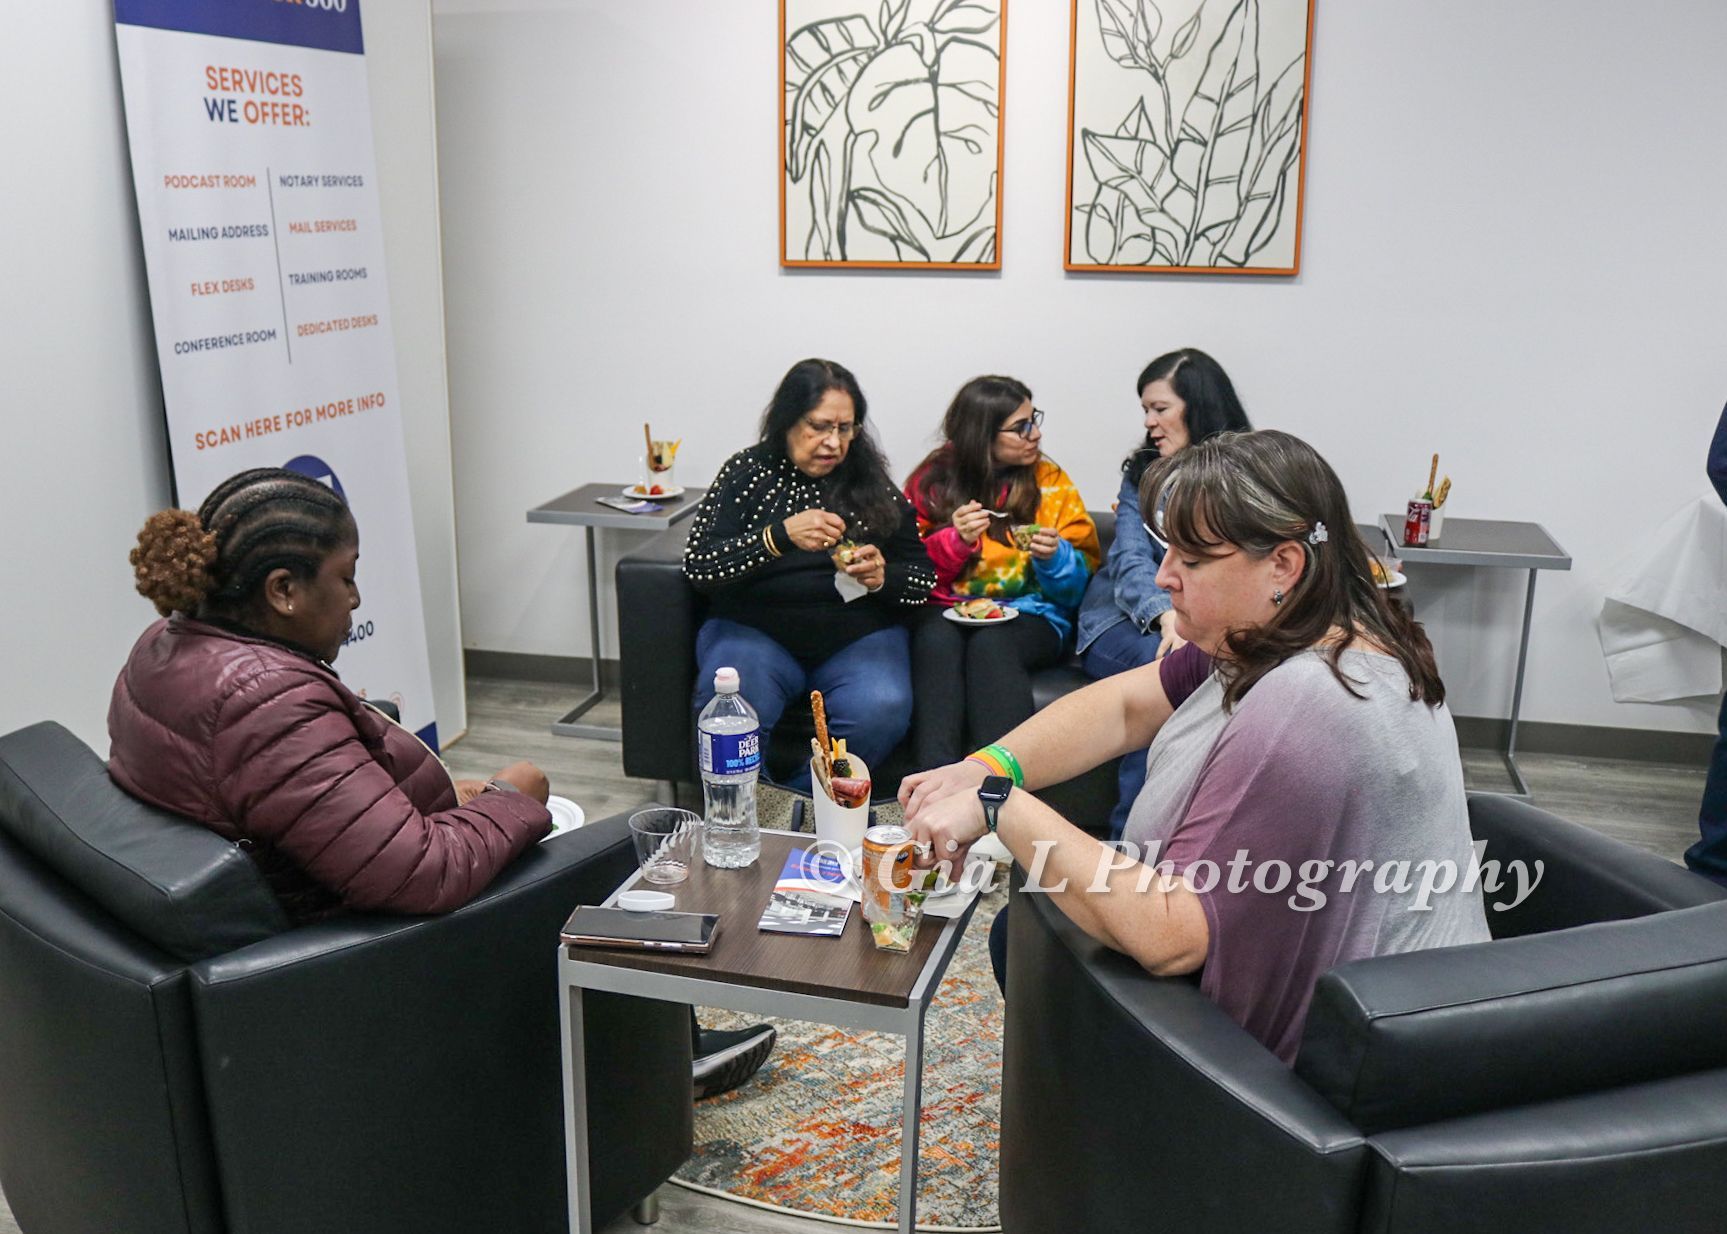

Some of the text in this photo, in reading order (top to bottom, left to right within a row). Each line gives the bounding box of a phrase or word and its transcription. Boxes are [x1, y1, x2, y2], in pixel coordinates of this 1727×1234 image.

[206, 65, 303, 97] SERVICES
[203, 97, 310, 127] WE OFFER:
[164, 174, 257, 189] PODCAST ROOM
[280, 174, 364, 188] NOTARY SERVICES
[169, 223, 269, 242] MAILING ADDRESS
[289, 218, 357, 234] MAIL SERVICES
[288, 266, 368, 286] TRAINING ROOMS
[191, 277, 254, 297] FLEX DESKS
[297, 313, 378, 337] DEDICATED DESKS
[174, 328, 277, 355] CONFERENCE ROOM
[195, 391, 386, 451] SCAN HERE FOR MORE INFO
